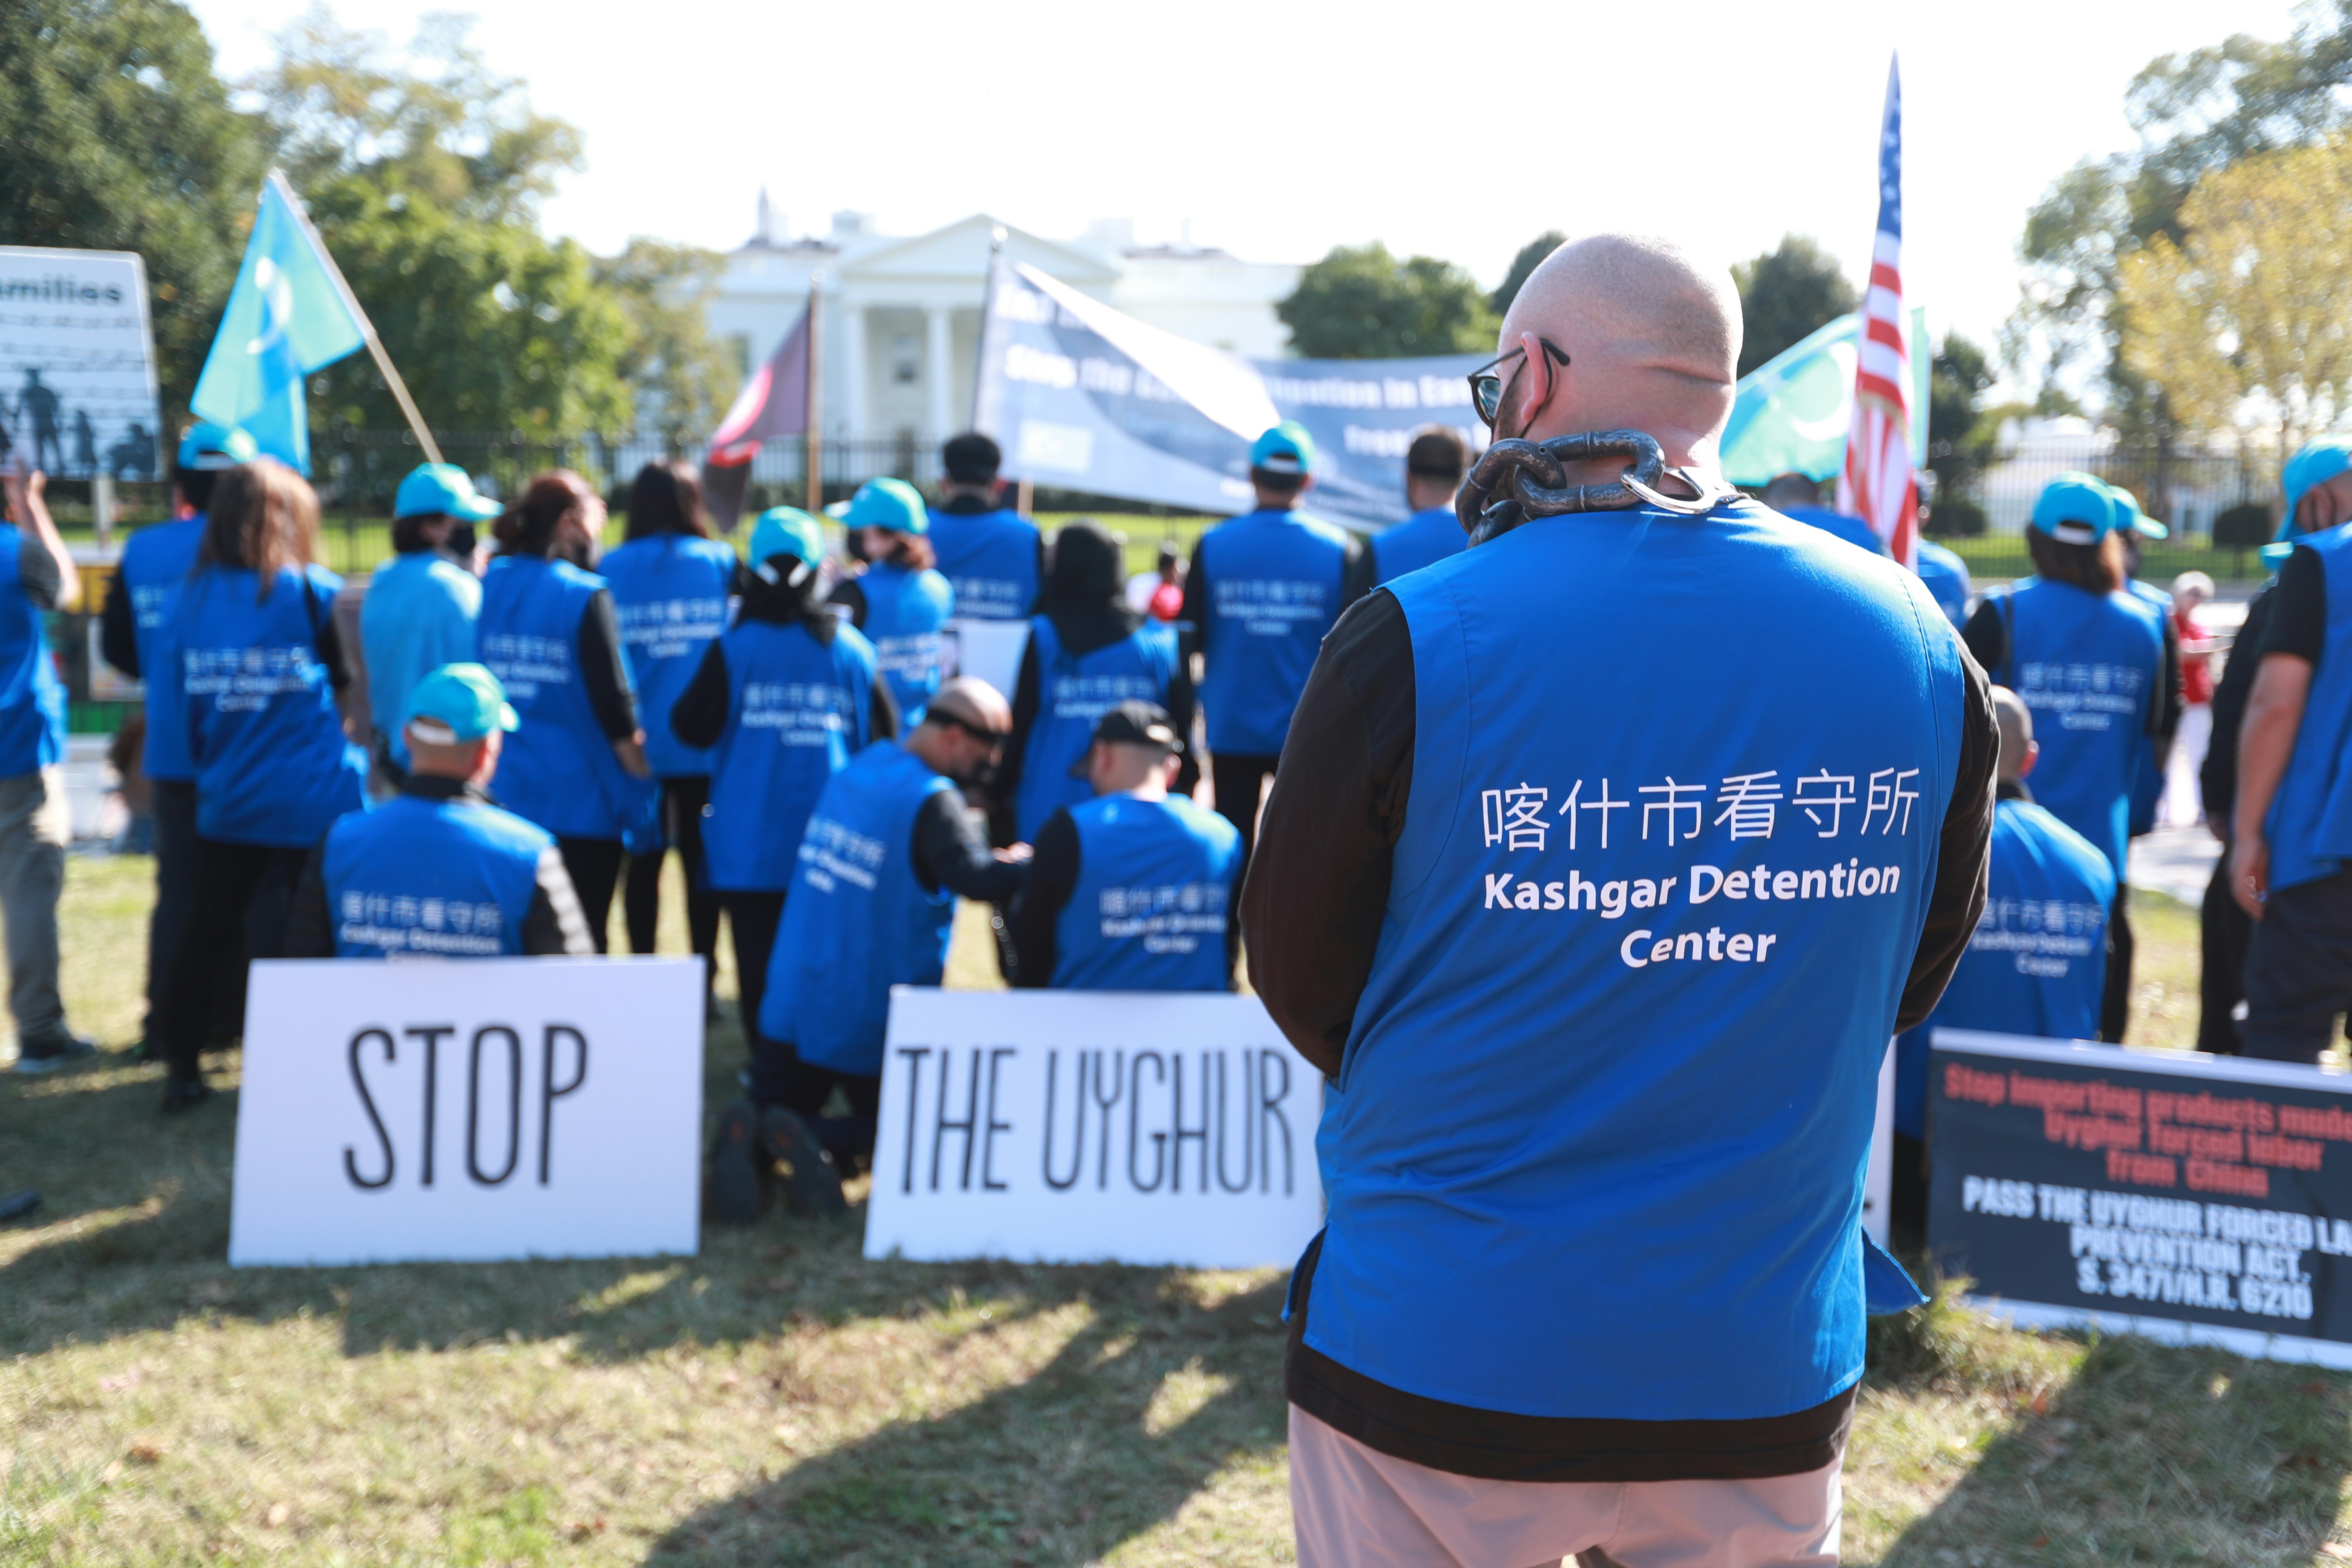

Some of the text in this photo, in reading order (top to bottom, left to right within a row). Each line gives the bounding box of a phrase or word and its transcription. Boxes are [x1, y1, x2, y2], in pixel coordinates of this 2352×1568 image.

[0, 274, 122, 303] milies
[1482, 767, 1920, 851] 喀什市看守所
[1484, 858, 1900, 919] Kashgar Detention
[1620, 926, 1776, 968] Center
[343, 1022, 588, 1190] STOP
[896, 1047, 1295, 1197] THE UYGHUR
[1944, 1062, 2006, 1108] Stop
[2009, 1069, 2142, 1122] importing
[2146, 1090, 2275, 1134] products
[2044, 1105, 2324, 1172] Uyghur forced labor
[2107, 1148, 2269, 1198] from China
[1962, 1174, 2035, 1219] PASS
[2037, 1183, 2089, 1224] THE
[2090, 1188, 2203, 1236] UYGHUR
[2204, 1201, 2314, 1251] FORCED
[2070, 1222, 2242, 1277] PREVENTION
[2238, 1274, 2315, 1320] 6210
